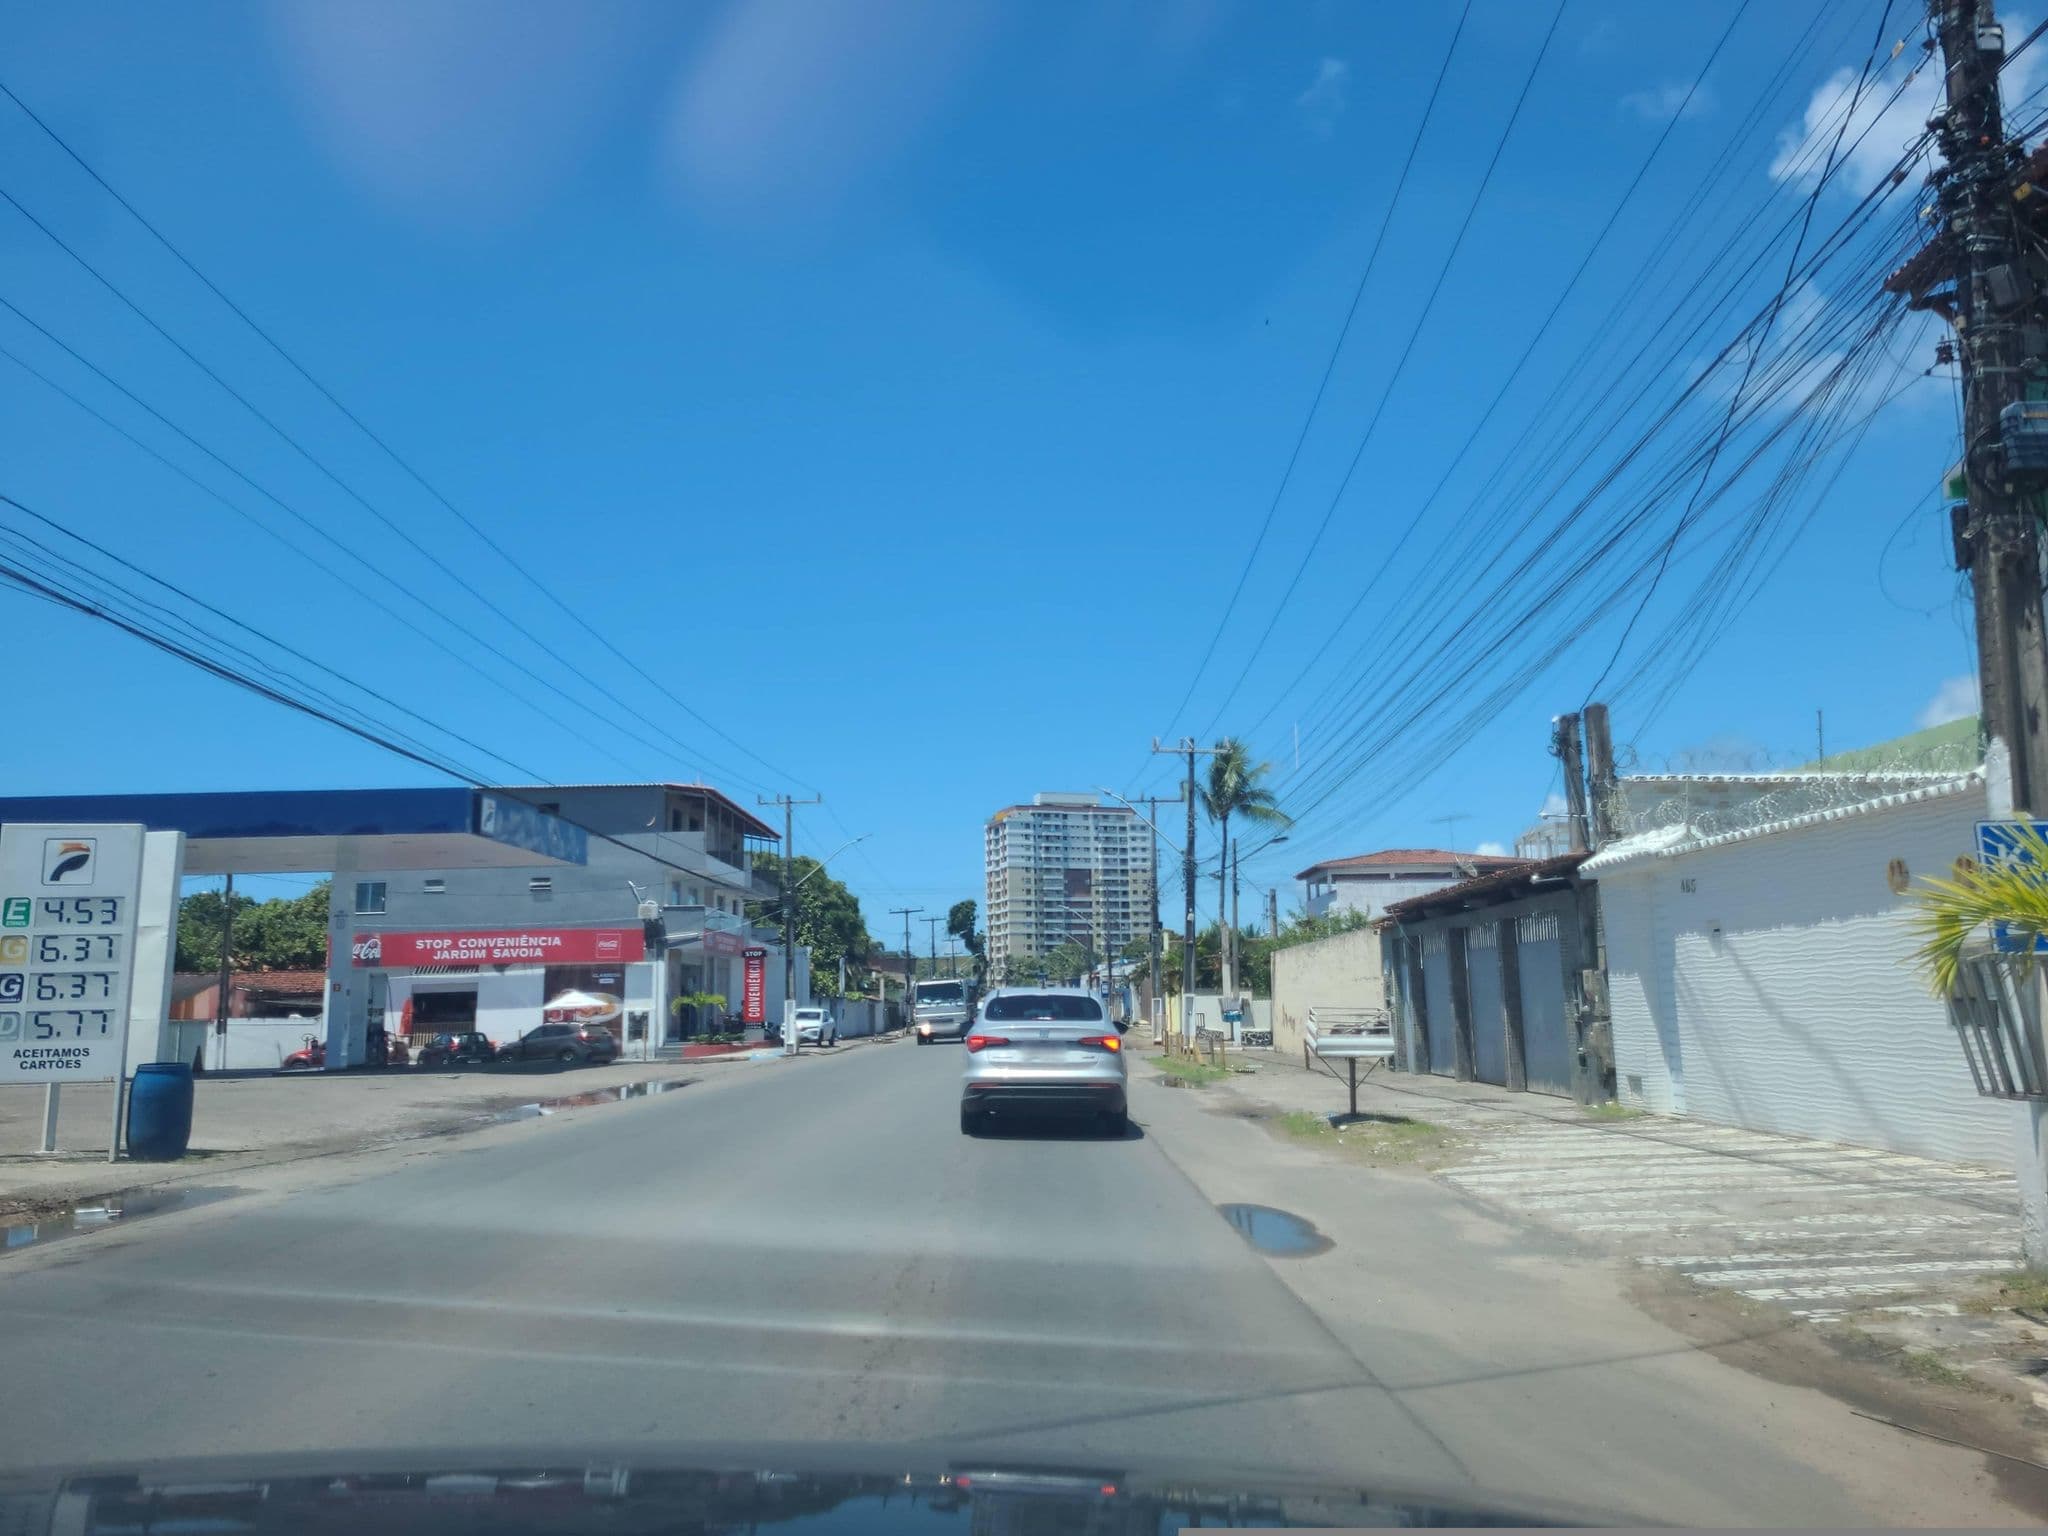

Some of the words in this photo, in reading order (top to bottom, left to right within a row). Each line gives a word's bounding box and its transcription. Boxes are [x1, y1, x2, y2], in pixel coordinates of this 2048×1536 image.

[6, 899, 28, 920] E
[44, 899, 117, 924] 4.53
[40, 936, 113, 962] 6.37
[415, 939, 453, 950] STOP
[458, 935, 562, 949] CONVENIÊNCIA
[432, 949, 487, 960] JARDIM
[492, 947, 544, 958] SAVOIA
[0, 975, 22, 998] G
[36, 973, 109, 1001] 6.37
[746, 960, 760, 1017] CONVENIÊNCIA
[33, 1010, 108, 1039] 5.77
[13, 1048, 91, 1059] ACEITAMOS
[19, 1058, 82, 1070] CARTÕES
